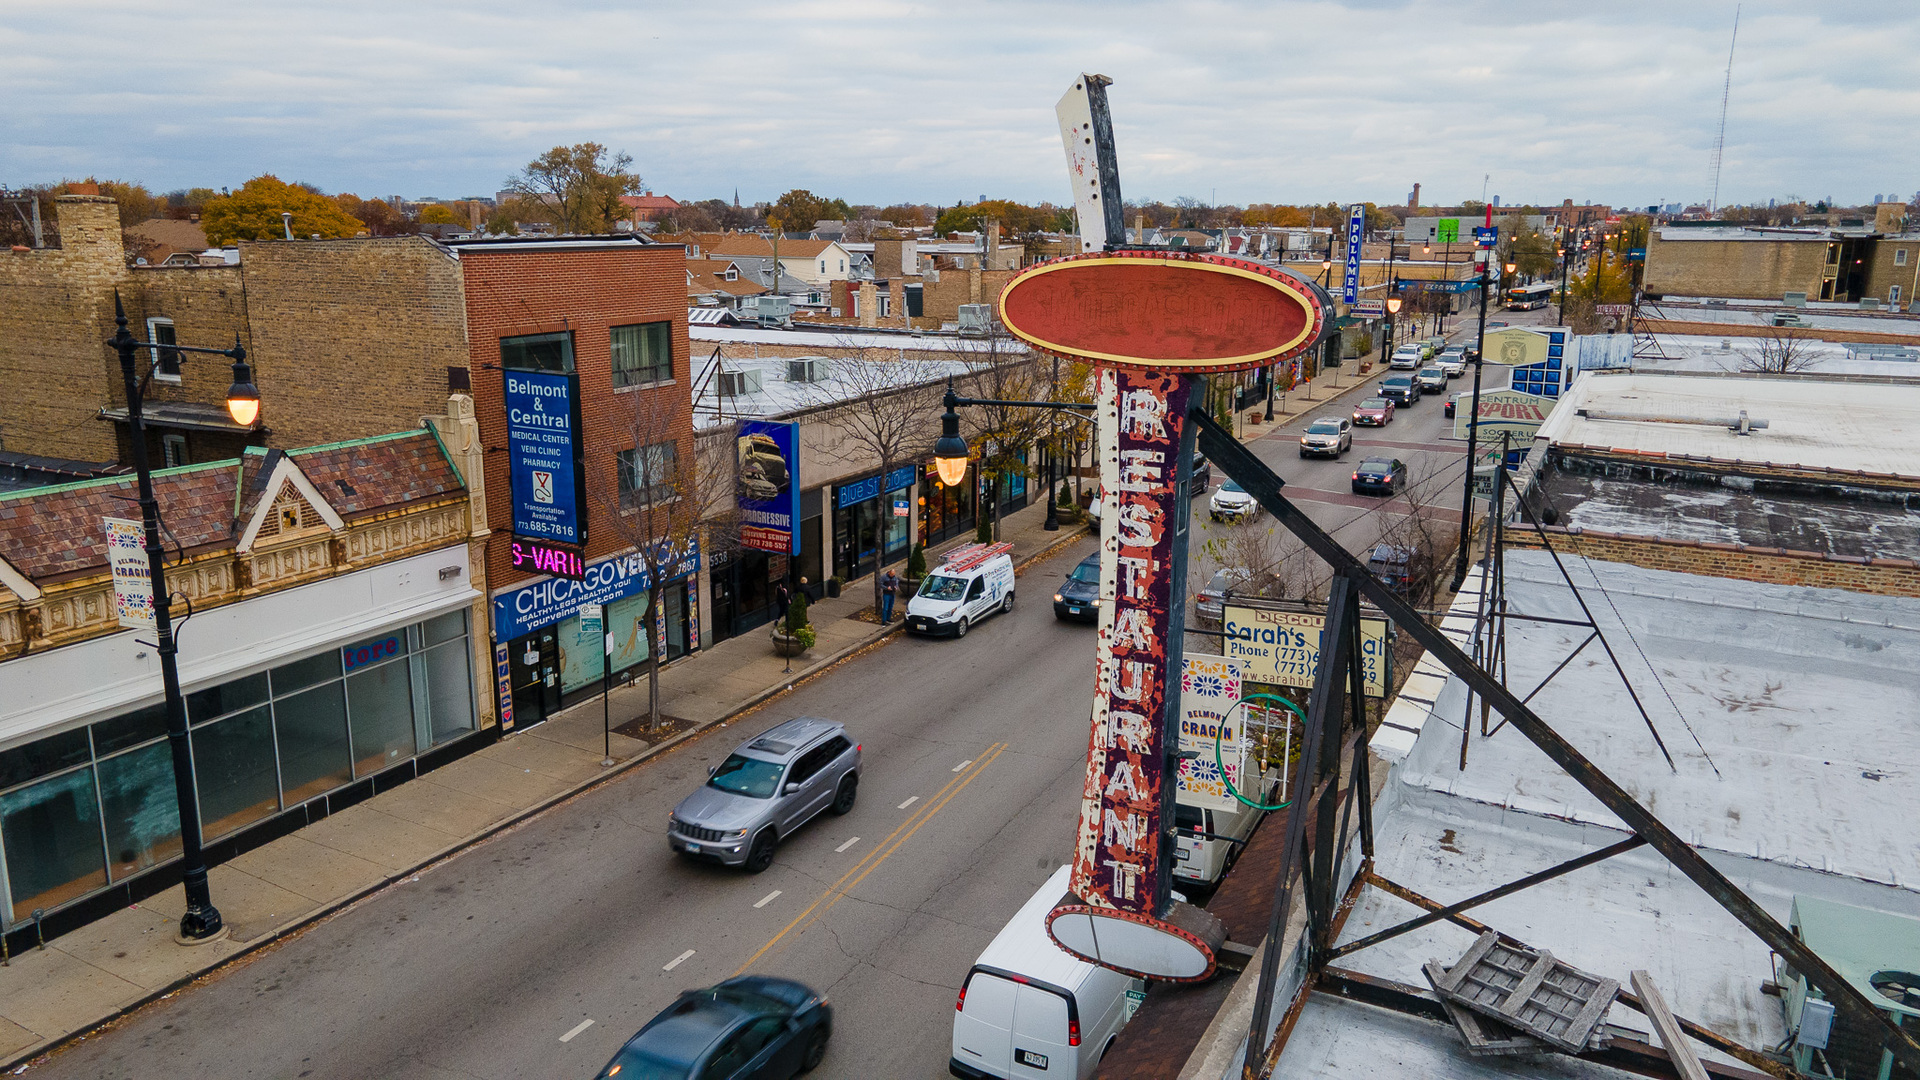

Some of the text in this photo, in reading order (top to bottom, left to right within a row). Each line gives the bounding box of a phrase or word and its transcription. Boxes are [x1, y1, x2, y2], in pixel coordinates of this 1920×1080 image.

[1346, 224, 1359, 296] POLAMER
[508, 378, 567, 398] Belmont
[534, 397, 543, 411] &
[1479, 395, 1539, 405] CENTRUM
[510, 408, 568, 428] Central
[1469, 402, 1546, 420] SPORT
[511, 430, 570, 444] MEDICAL CENTER
[1482, 428, 1526, 438] SOCER
[520, 444, 561, 457] VEIN CLINIC
[522, 458, 560, 470] PHARMACY
[841, 482, 864, 504] Blue
[867, 473, 900, 494] Stdio
[524, 502, 566, 516] Transportation
[532, 512, 558, 522] Available
[742, 508, 790, 527] PROGRESSIVE
[118, 558, 145, 567] BELMONT
[710, 550, 728, 567] 5538
[115, 567, 151, 579] CRAGIN
[516, 562, 615, 614] CHICAGO
[516, 578, 631, 624] HEALTHY LEGS HEALTHY YOU!
[526, 589, 624, 631] yourveinexert.com
[1256, 611, 1325, 628] DISCOU
[1226, 621, 1306, 648] Sarah's
[1102, 389, 1170, 899] RESTAURANT
[1230, 642, 1268, 657] Phone
[345, 638, 397, 668] tore
[1187, 710, 1226, 722] BELMONT
[1130, 992, 1141, 1000] PAY
